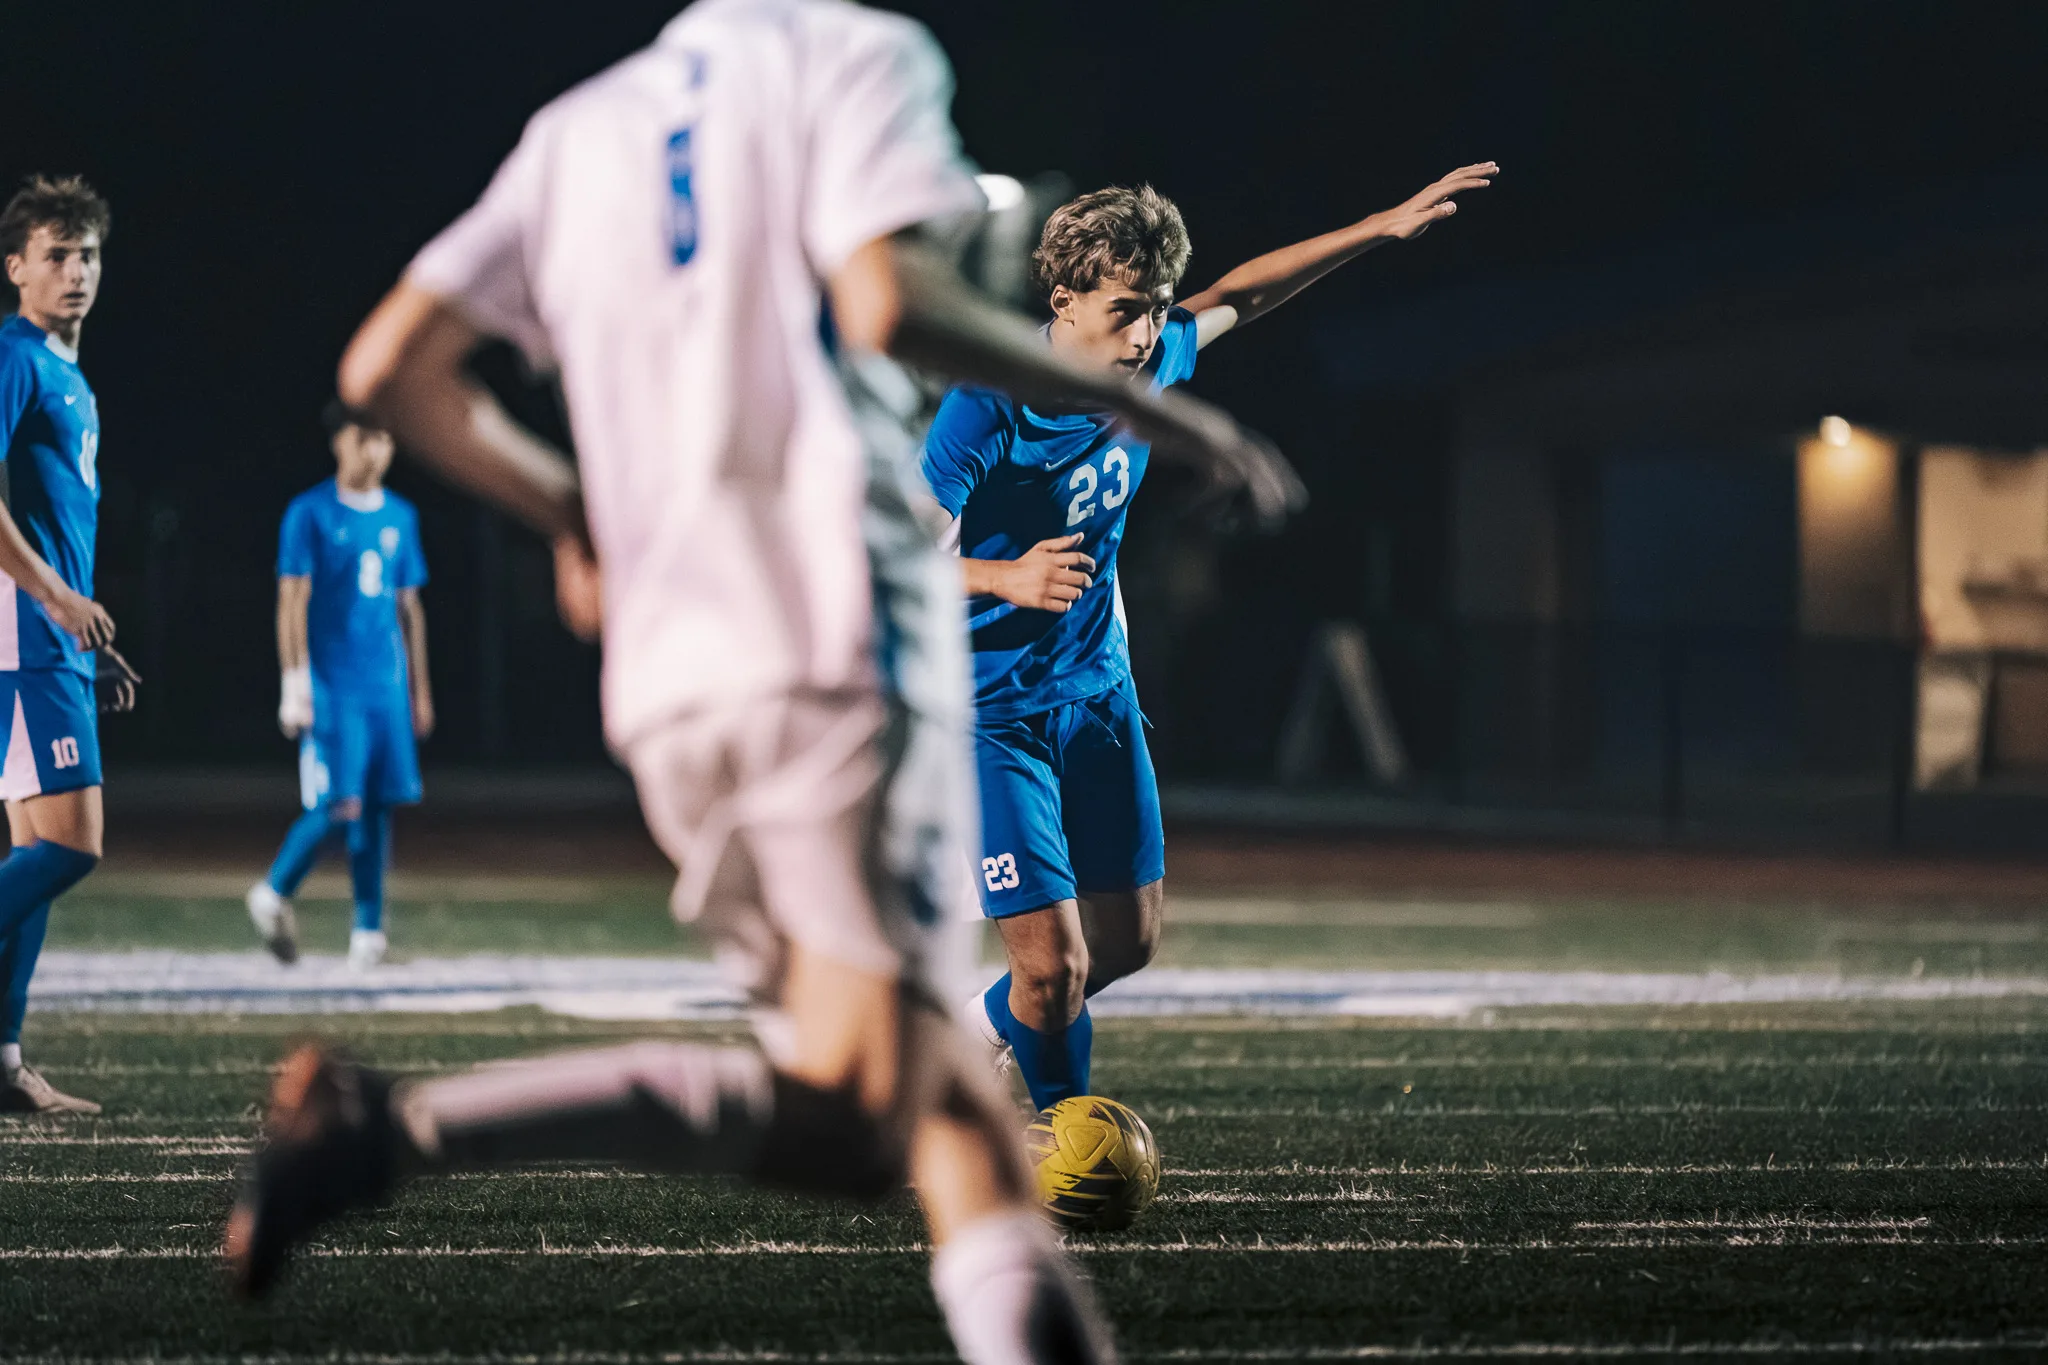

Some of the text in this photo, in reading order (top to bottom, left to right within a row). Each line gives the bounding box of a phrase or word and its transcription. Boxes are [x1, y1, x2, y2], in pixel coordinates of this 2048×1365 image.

[1066, 445, 1130, 528] 23
[51, 736, 80, 769] 10
[981, 852, 1020, 892] 23
